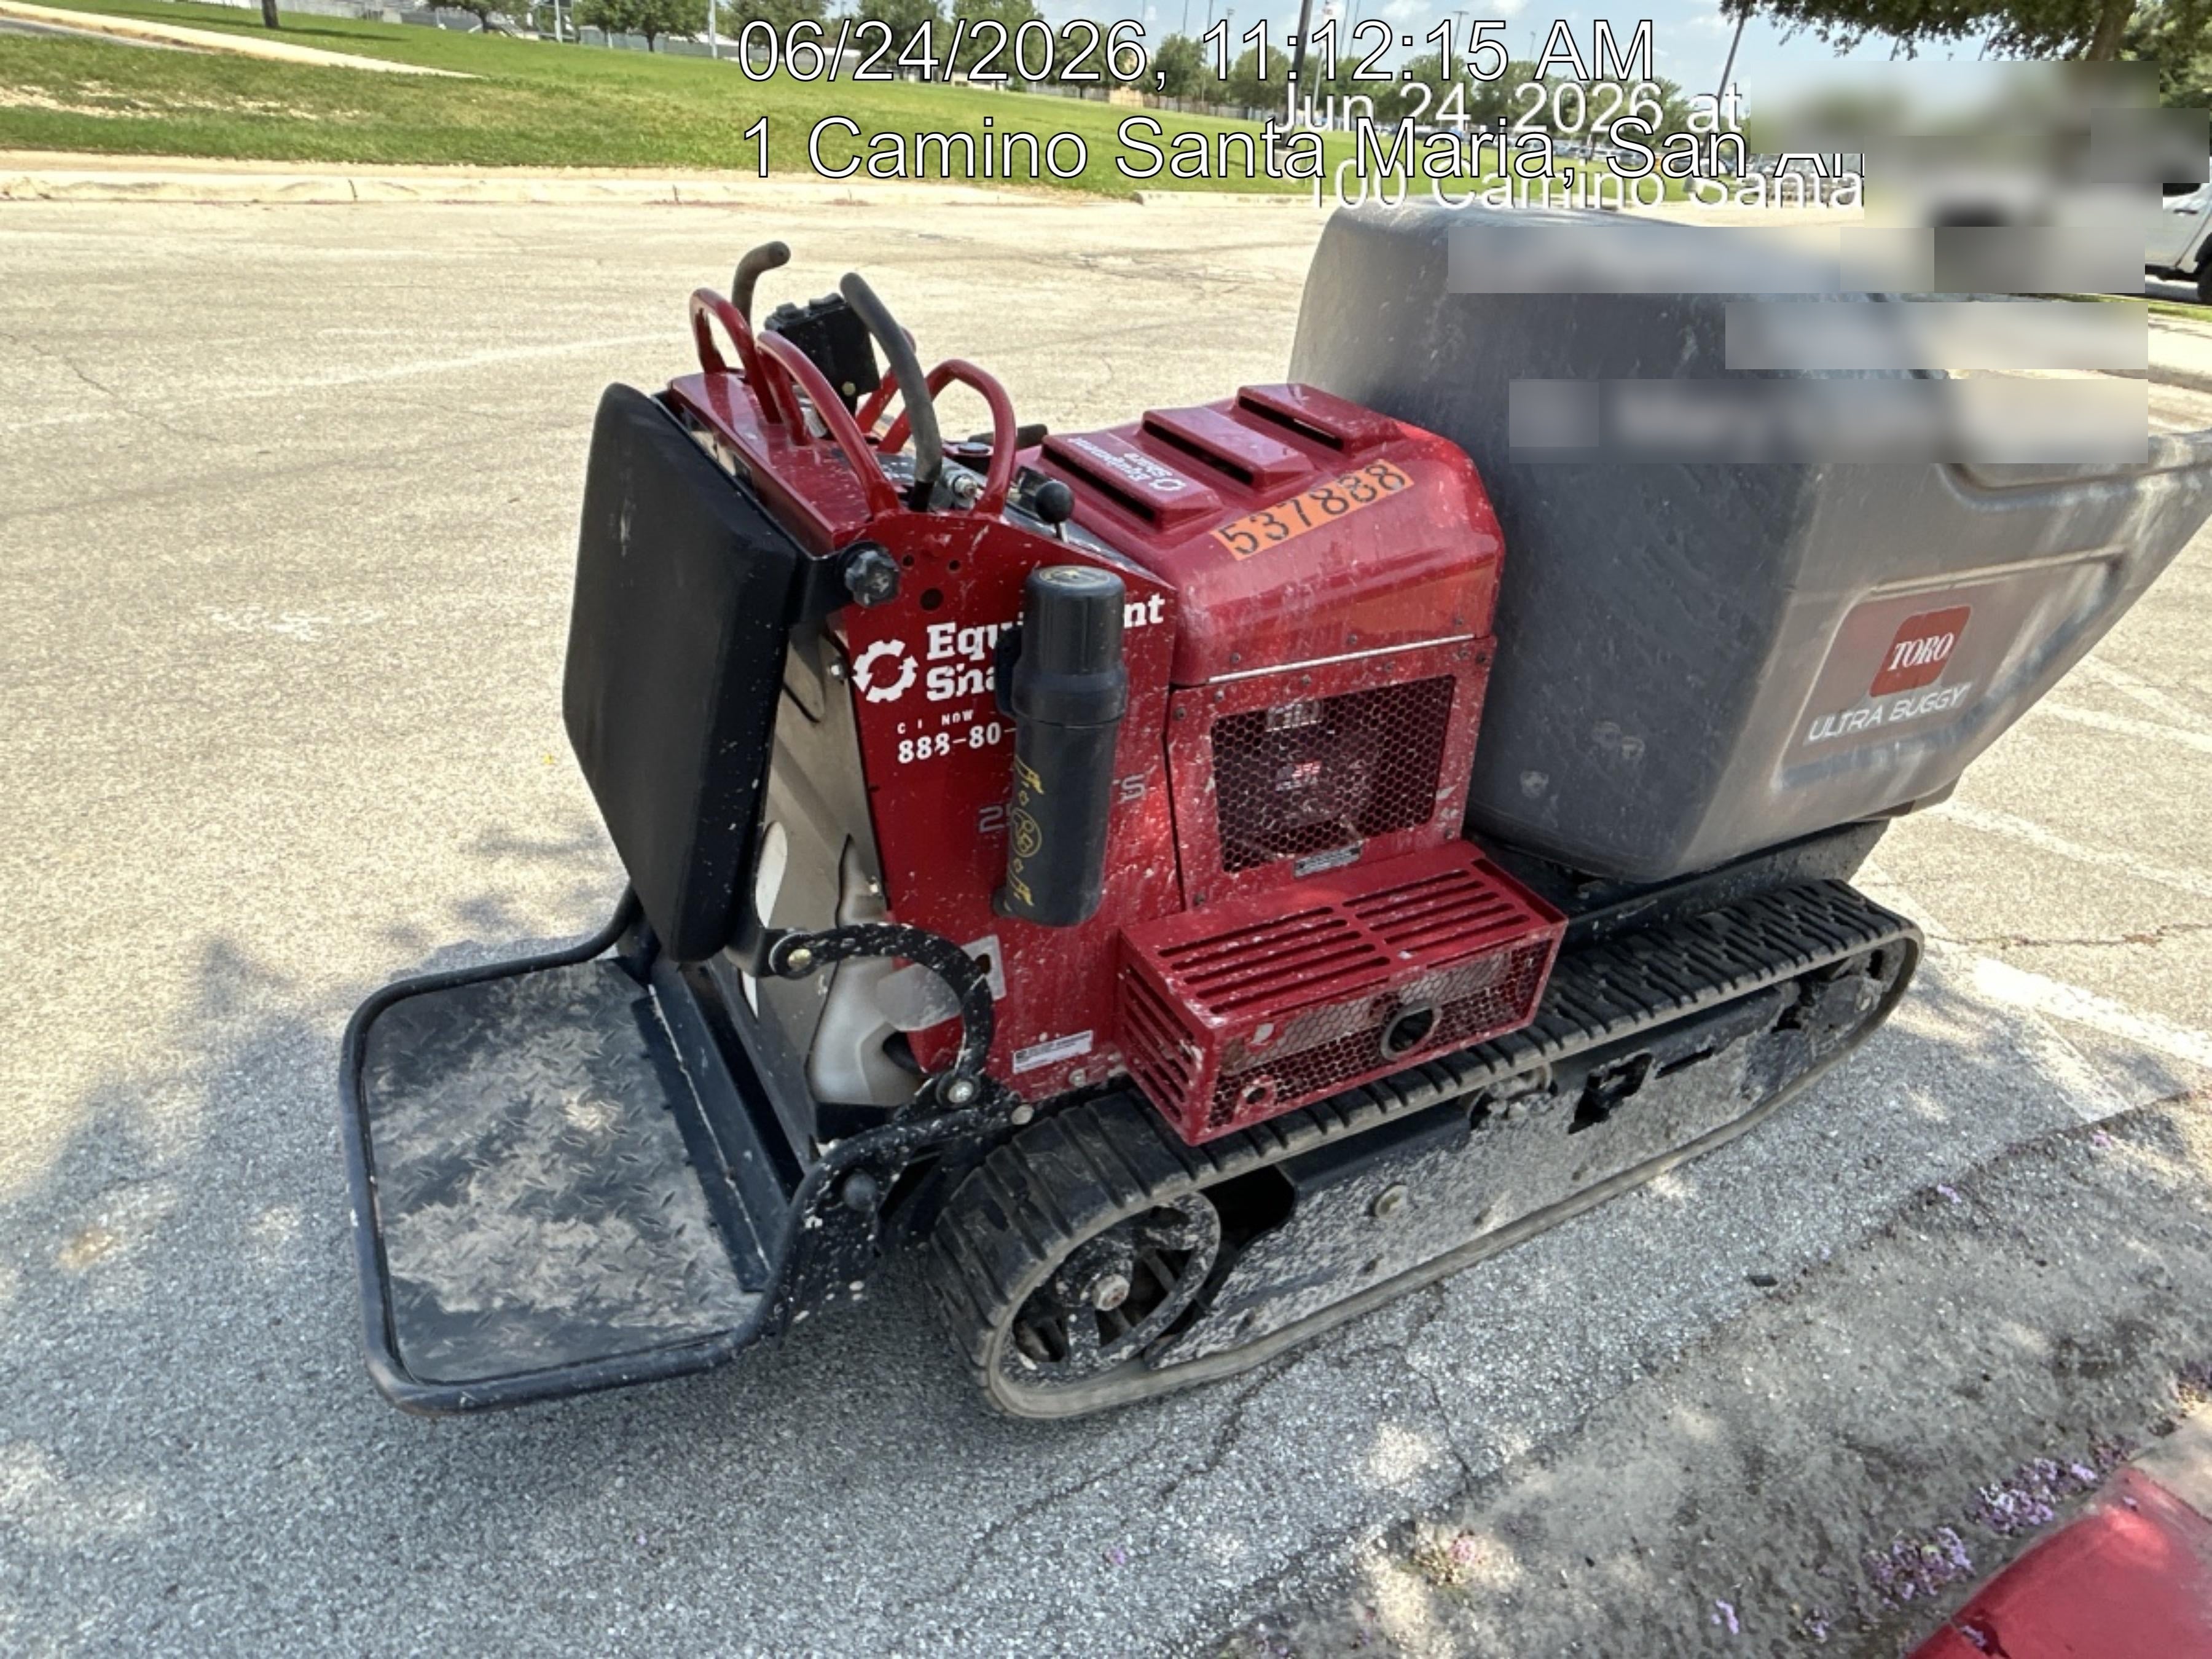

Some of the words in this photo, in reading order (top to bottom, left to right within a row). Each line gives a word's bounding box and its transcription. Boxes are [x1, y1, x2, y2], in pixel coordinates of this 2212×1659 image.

[1218, 463, 1406, 554] 537888
[1887, 632, 1955, 672] TORO
[941, 709, 974, 726] NOW
[1809, 705, 1883, 742] ULTRA
[1888, 682, 1971, 722] BUGGY
